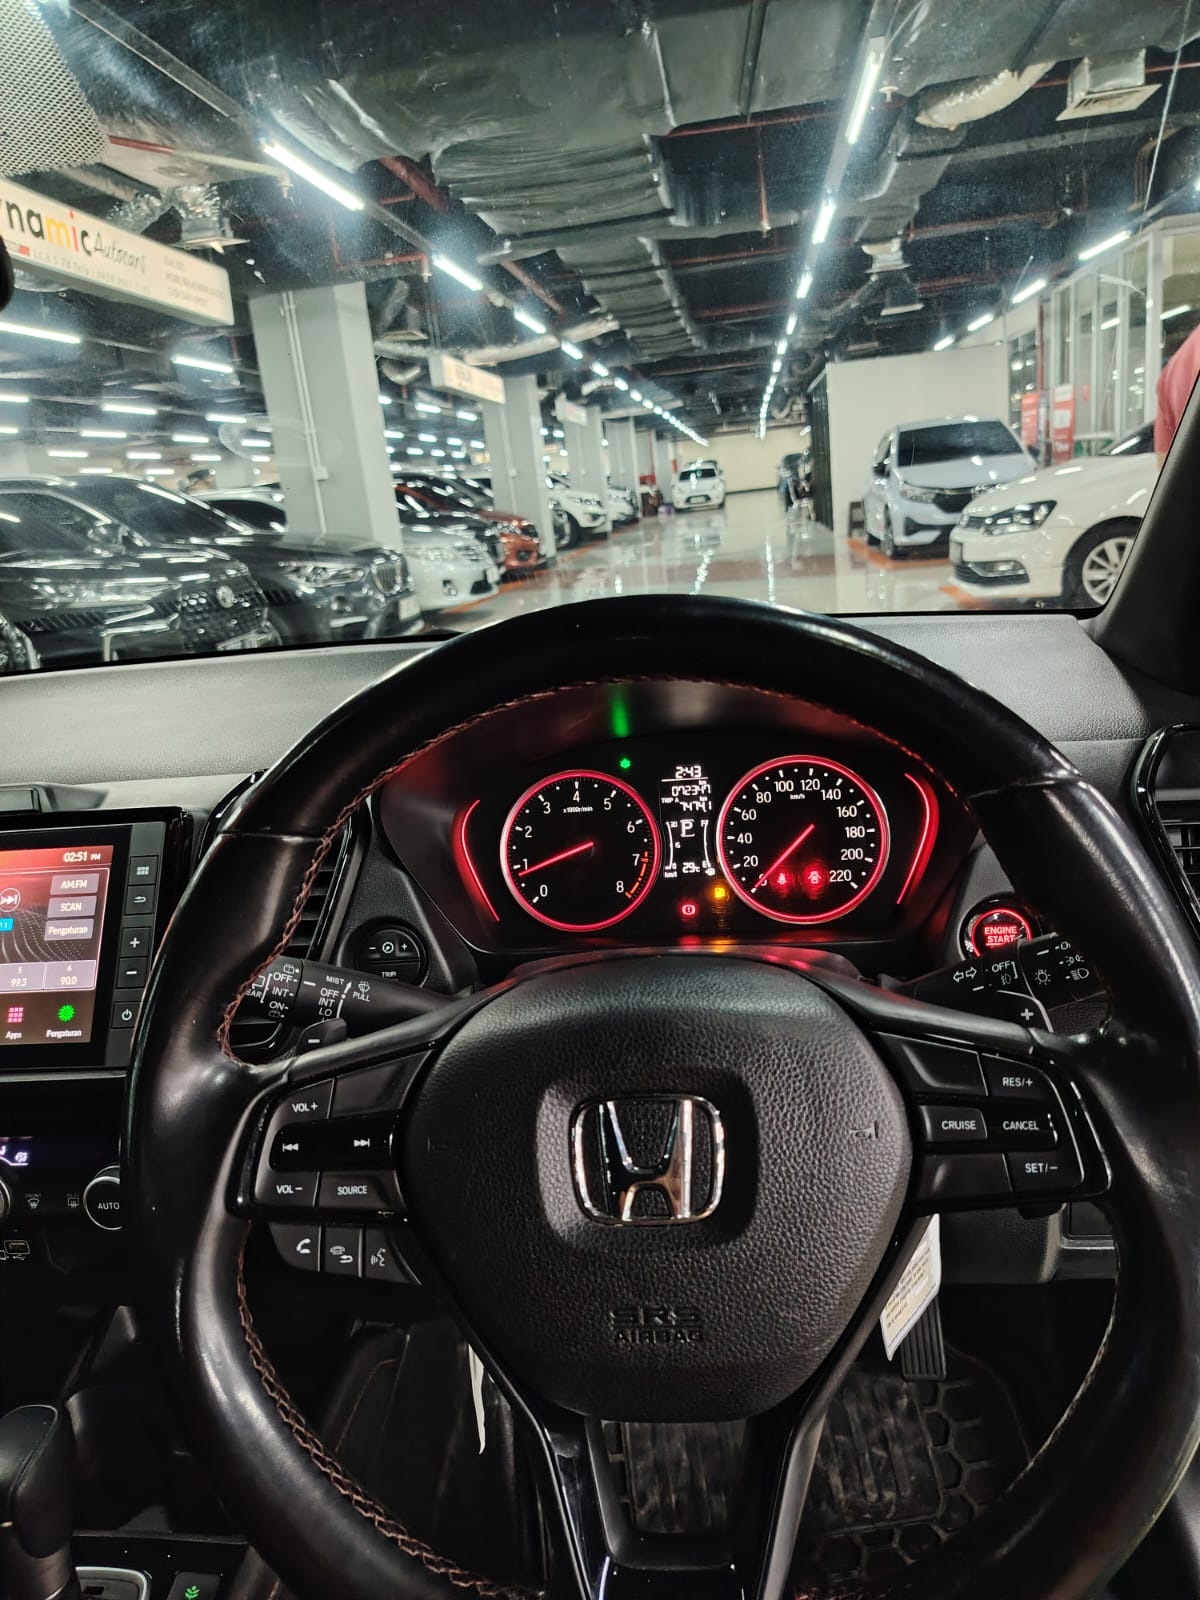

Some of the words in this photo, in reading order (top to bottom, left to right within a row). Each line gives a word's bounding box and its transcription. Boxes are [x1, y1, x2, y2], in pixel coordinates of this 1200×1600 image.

[0, 200, 92, 257] namic
[774, 780, 794, 792] 100
[800, 778, 820, 791] 120
[572, 790, 580, 802] 4
[756, 791, 772, 803] 80
[821, 789, 841, 801] 140
[543, 802, 551, 814] 3
[603, 798, 612, 810] 5
[741, 809, 757, 821] 60
[836, 806, 857, 818] 160
[524, 826, 533, 838] 2
[627, 821, 635, 833] 6
[844, 826, 865, 838] 180
[737, 832, 752, 844] 40
[63, 851, 88, 862] 02:51
[632, 854, 640, 866] 7
[840, 848, 863, 860] 200
[522, 859, 528, 870] 1
[743, 855, 758, 867] 20
[829, 870, 852, 882] 220
[539, 884, 548, 897] 0
[616, 881, 624, 893] 8
[60, 902, 82, 912] SCAN
[48, 925, 88, 936] Pengaturan
[984, 926, 1018, 935] ENGINE
[987, 934, 1015, 943] START
[991, 960, 1010, 973] OFF
[273, 972, 293, 983] OFF
[326, 975, 345, 985] MIST
[246, 989, 262, 998] EAR
[272, 986, 289, 998] INT
[320, 987, 340, 998] OFF
[352, 991, 370, 1002] PULL
[269, 1001, 285, 1010] ON
[318, 997, 335, 1007] INT
[318, 1007, 332, 1017] LO
[5, 1030, 22, 1040] Apps
[1002, 1077, 1033, 1088] RES/+
[941, 1121, 976, 1130] CRUISE
[1003, 1121, 1039, 1131] CANCEL
[337, 1185, 368, 1196] SOURCE
[98, 1202, 120, 1210] AUTO
